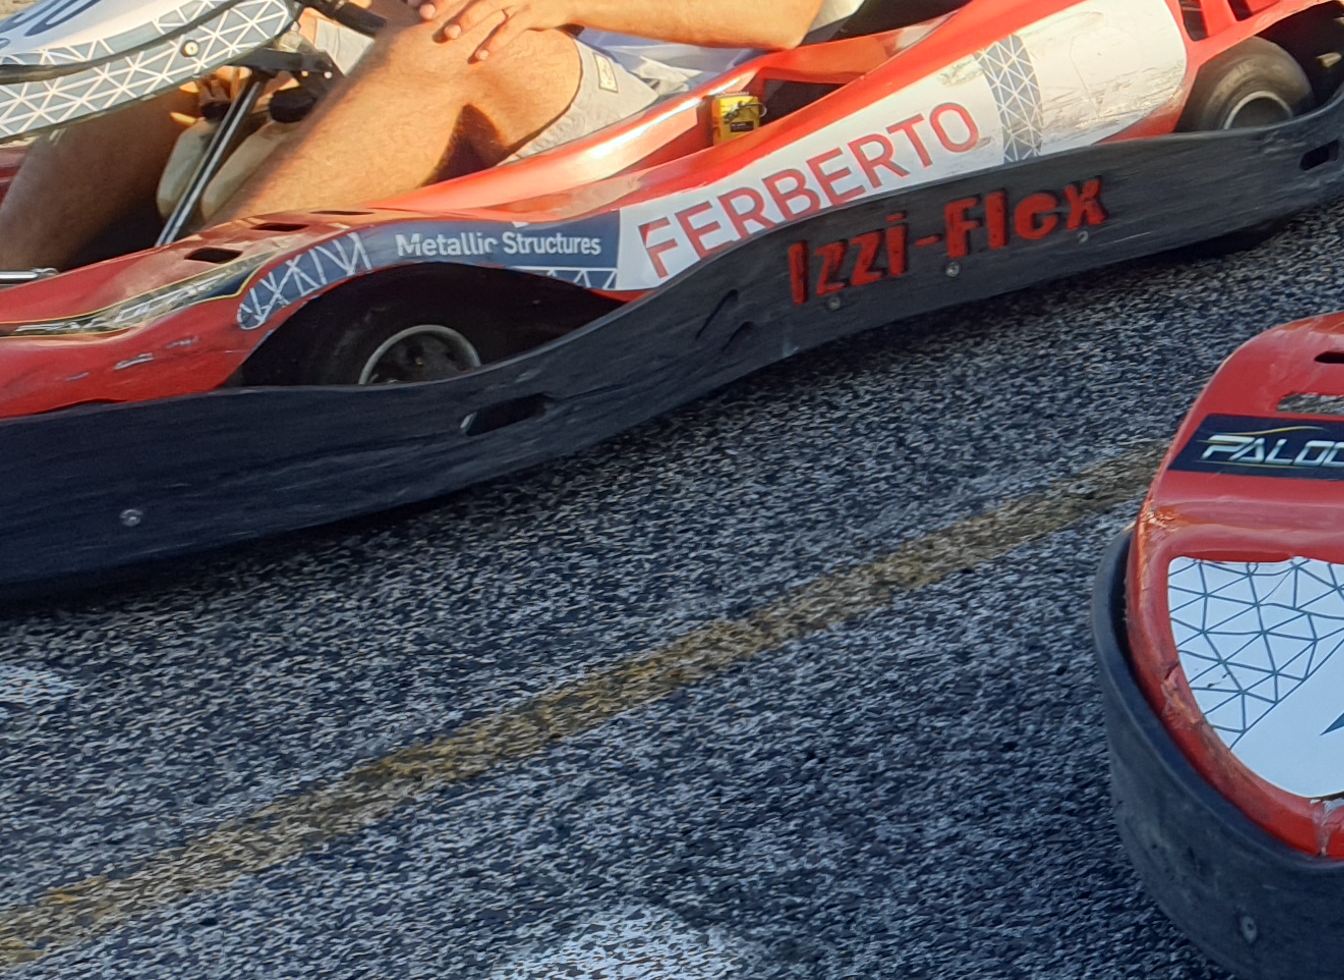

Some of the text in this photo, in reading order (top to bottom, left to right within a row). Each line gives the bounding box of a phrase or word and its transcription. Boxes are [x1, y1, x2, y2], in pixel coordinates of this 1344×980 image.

[638, 101, 980, 279] FERBERTO
[394, 230, 602, 257] Metallic Structures
